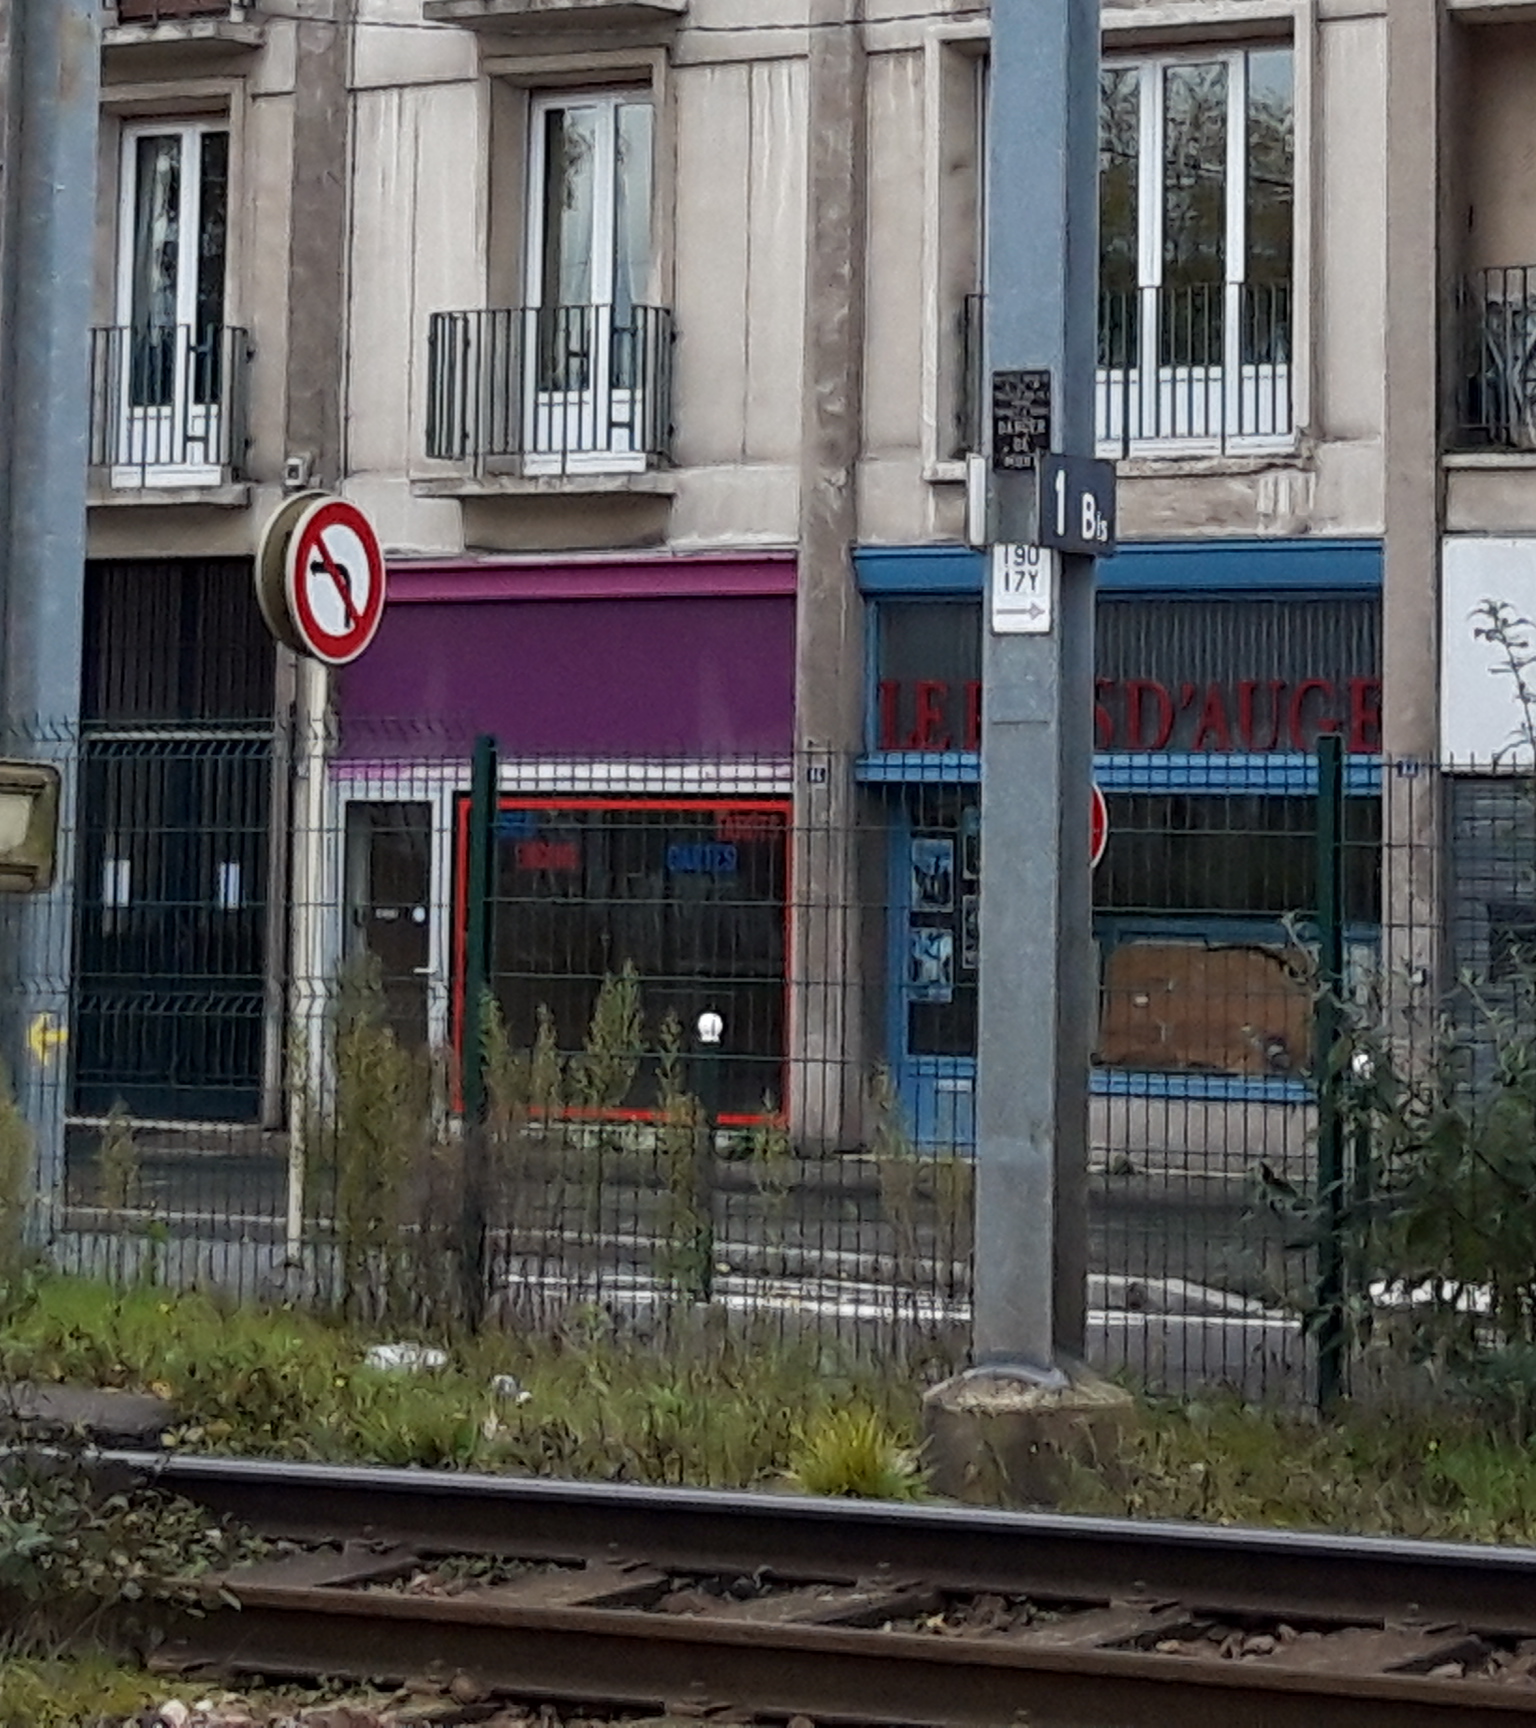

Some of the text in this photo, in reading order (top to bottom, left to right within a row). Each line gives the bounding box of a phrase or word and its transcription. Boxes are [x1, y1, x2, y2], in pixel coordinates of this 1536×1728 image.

[1055, 470, 1108, 542] 1 Bis
[1004, 570, 1039, 593] 17Y
[878, 679, 951, 751] LE
[1125, 676, 1382, 754] D'AUGE
